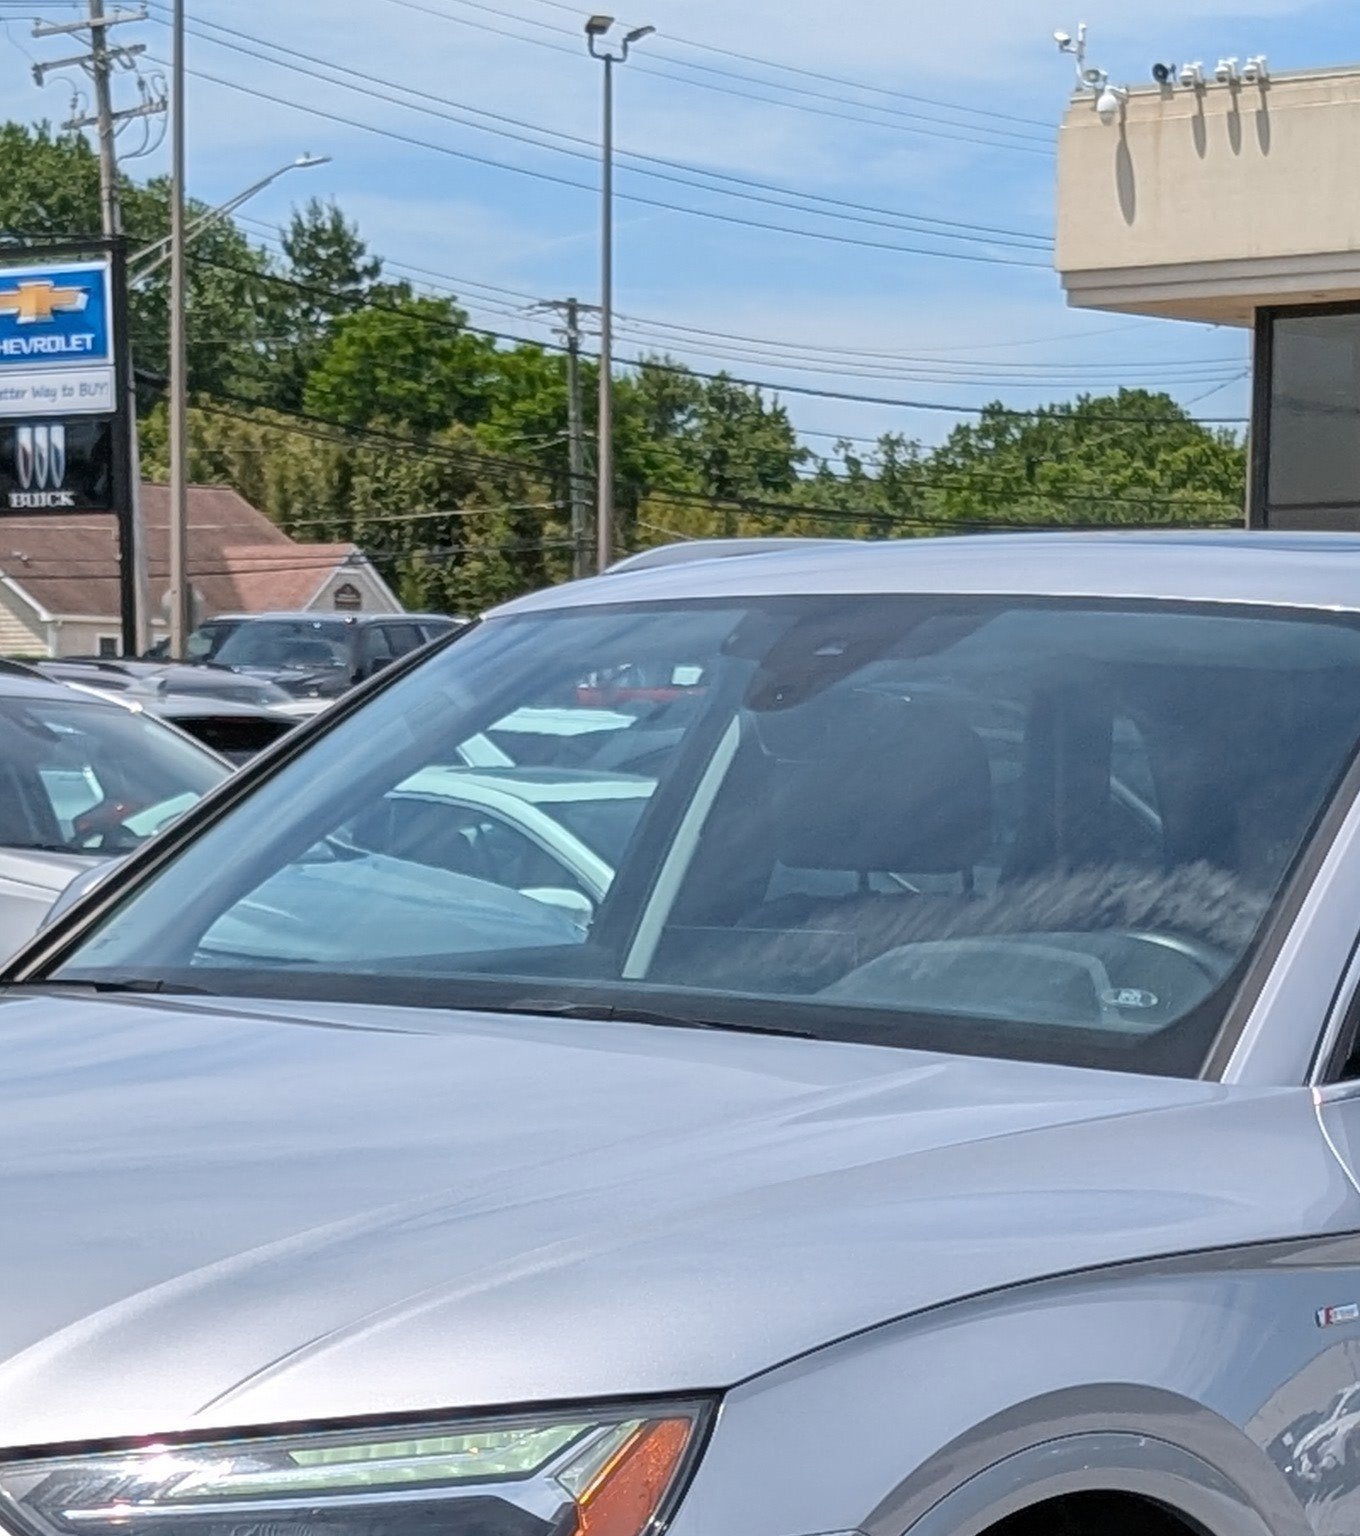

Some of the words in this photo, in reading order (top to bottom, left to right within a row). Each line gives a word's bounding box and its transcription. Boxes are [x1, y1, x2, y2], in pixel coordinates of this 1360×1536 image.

[31, 385, 58, 402] Way
[62, 384, 75, 398] to
[8, 491, 76, 508] BUICK
